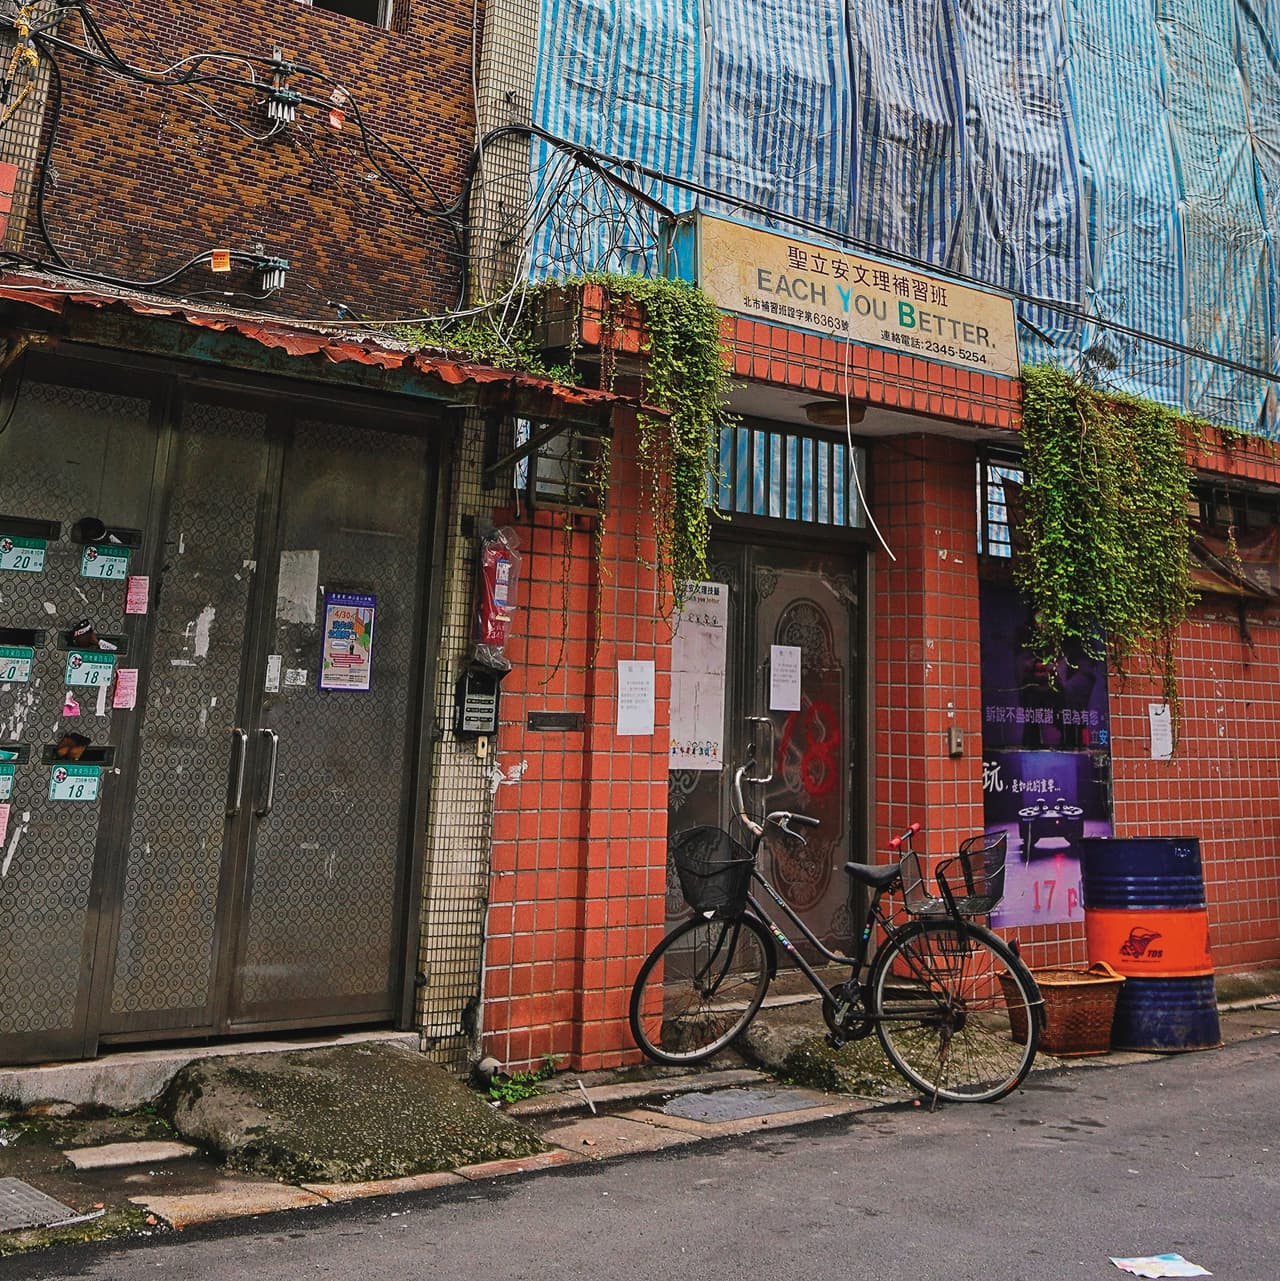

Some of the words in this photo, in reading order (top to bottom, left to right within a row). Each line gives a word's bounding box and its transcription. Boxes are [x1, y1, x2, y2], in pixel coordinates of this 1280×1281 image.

[787, 245, 948, 308] 聖立安文理補習班
[757, 268, 827, 306] EACH
[836, 284, 887, 321] YOU
[13, 555, 31, 569] 20
[99, 563, 115, 577] 18
[84, 671, 100, 684] 18
[69, 784, 85, 798] 18
[1033, 880, 1057, 911] 17
